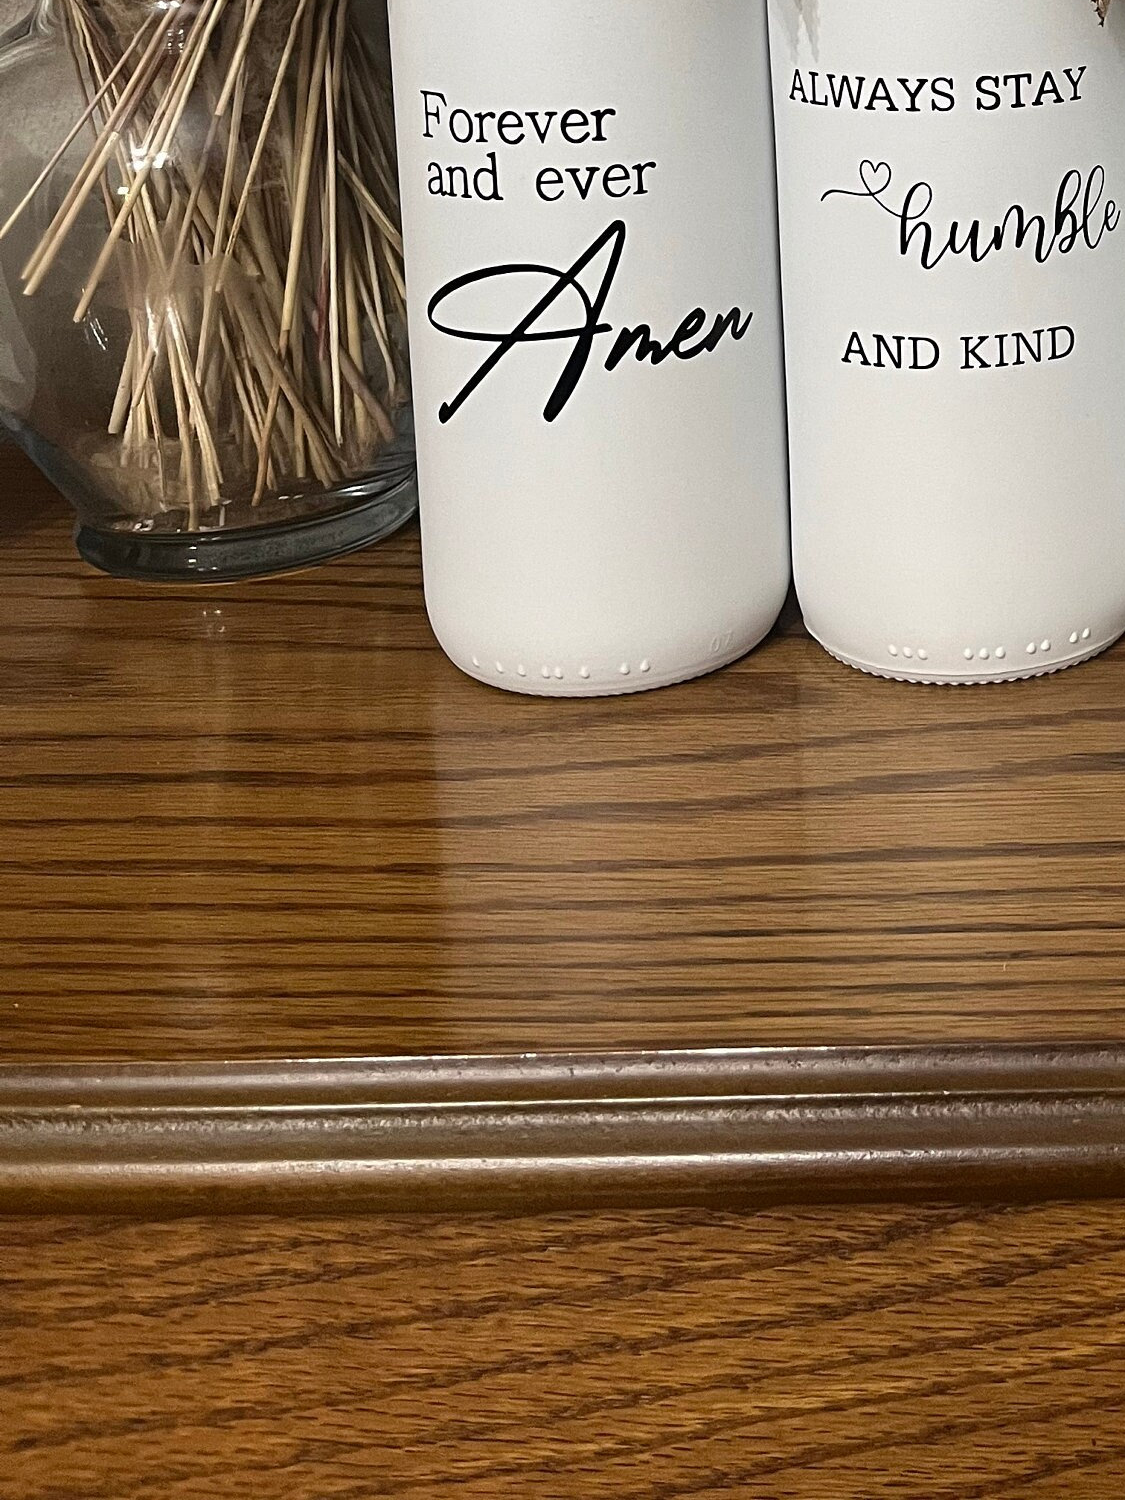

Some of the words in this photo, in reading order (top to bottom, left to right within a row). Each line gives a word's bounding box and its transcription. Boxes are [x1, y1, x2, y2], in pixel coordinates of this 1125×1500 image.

[788, 68, 955, 112] ALWAYS
[975, 65, 1087, 111] STAY
[419, 89, 617, 145] Forever
[427, 151, 504, 201] and
[535, 161, 657, 202] ever
[893, 164, 1121, 270] humble
[427, 219, 754, 425] Amen
[840, 331, 940, 370] AND
[959, 325, 1075, 370] KIND
